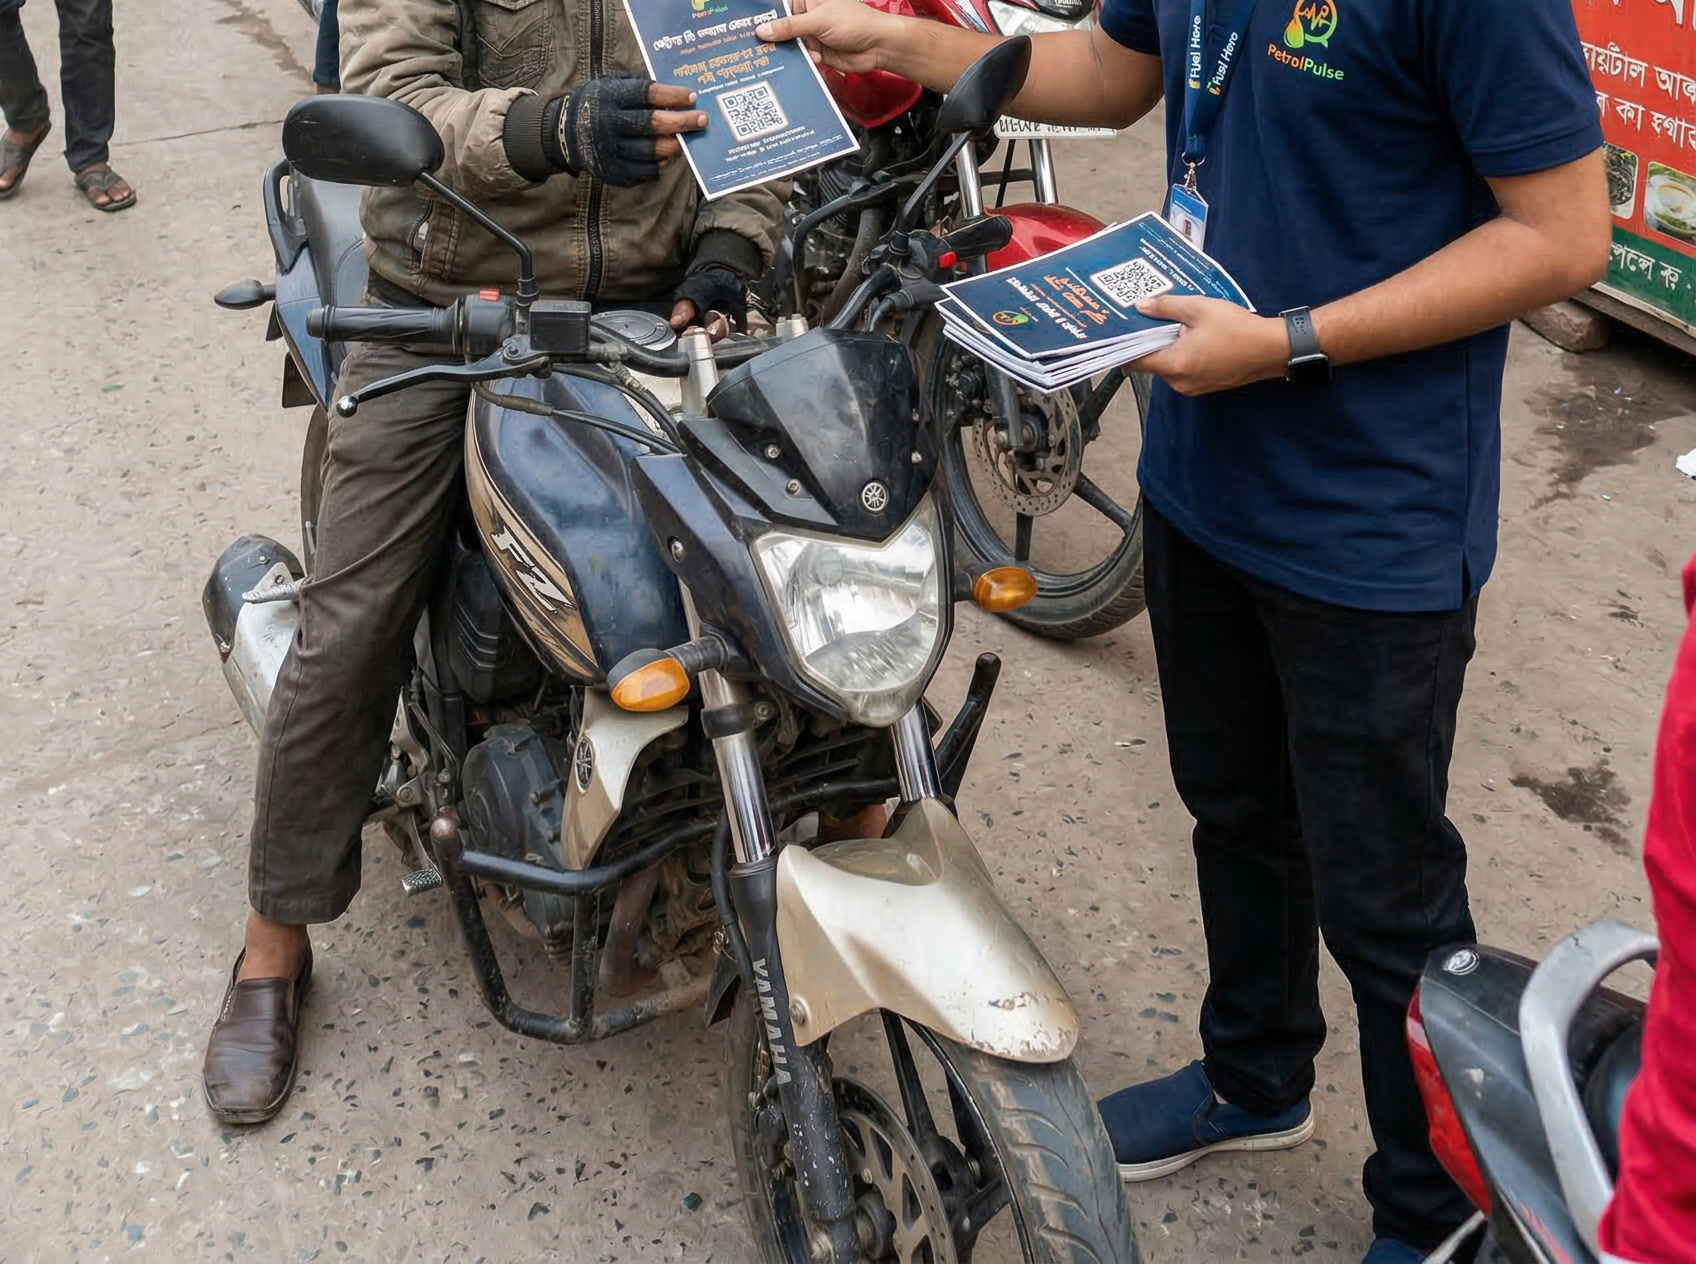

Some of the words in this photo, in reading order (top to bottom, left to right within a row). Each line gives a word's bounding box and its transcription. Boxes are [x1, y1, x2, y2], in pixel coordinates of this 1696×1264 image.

[1189, 52, 1201, 78] Fuel
[1267, 42, 1345, 81] PetrolPulse
[752, 957, 792, 1086] YAMAHA
